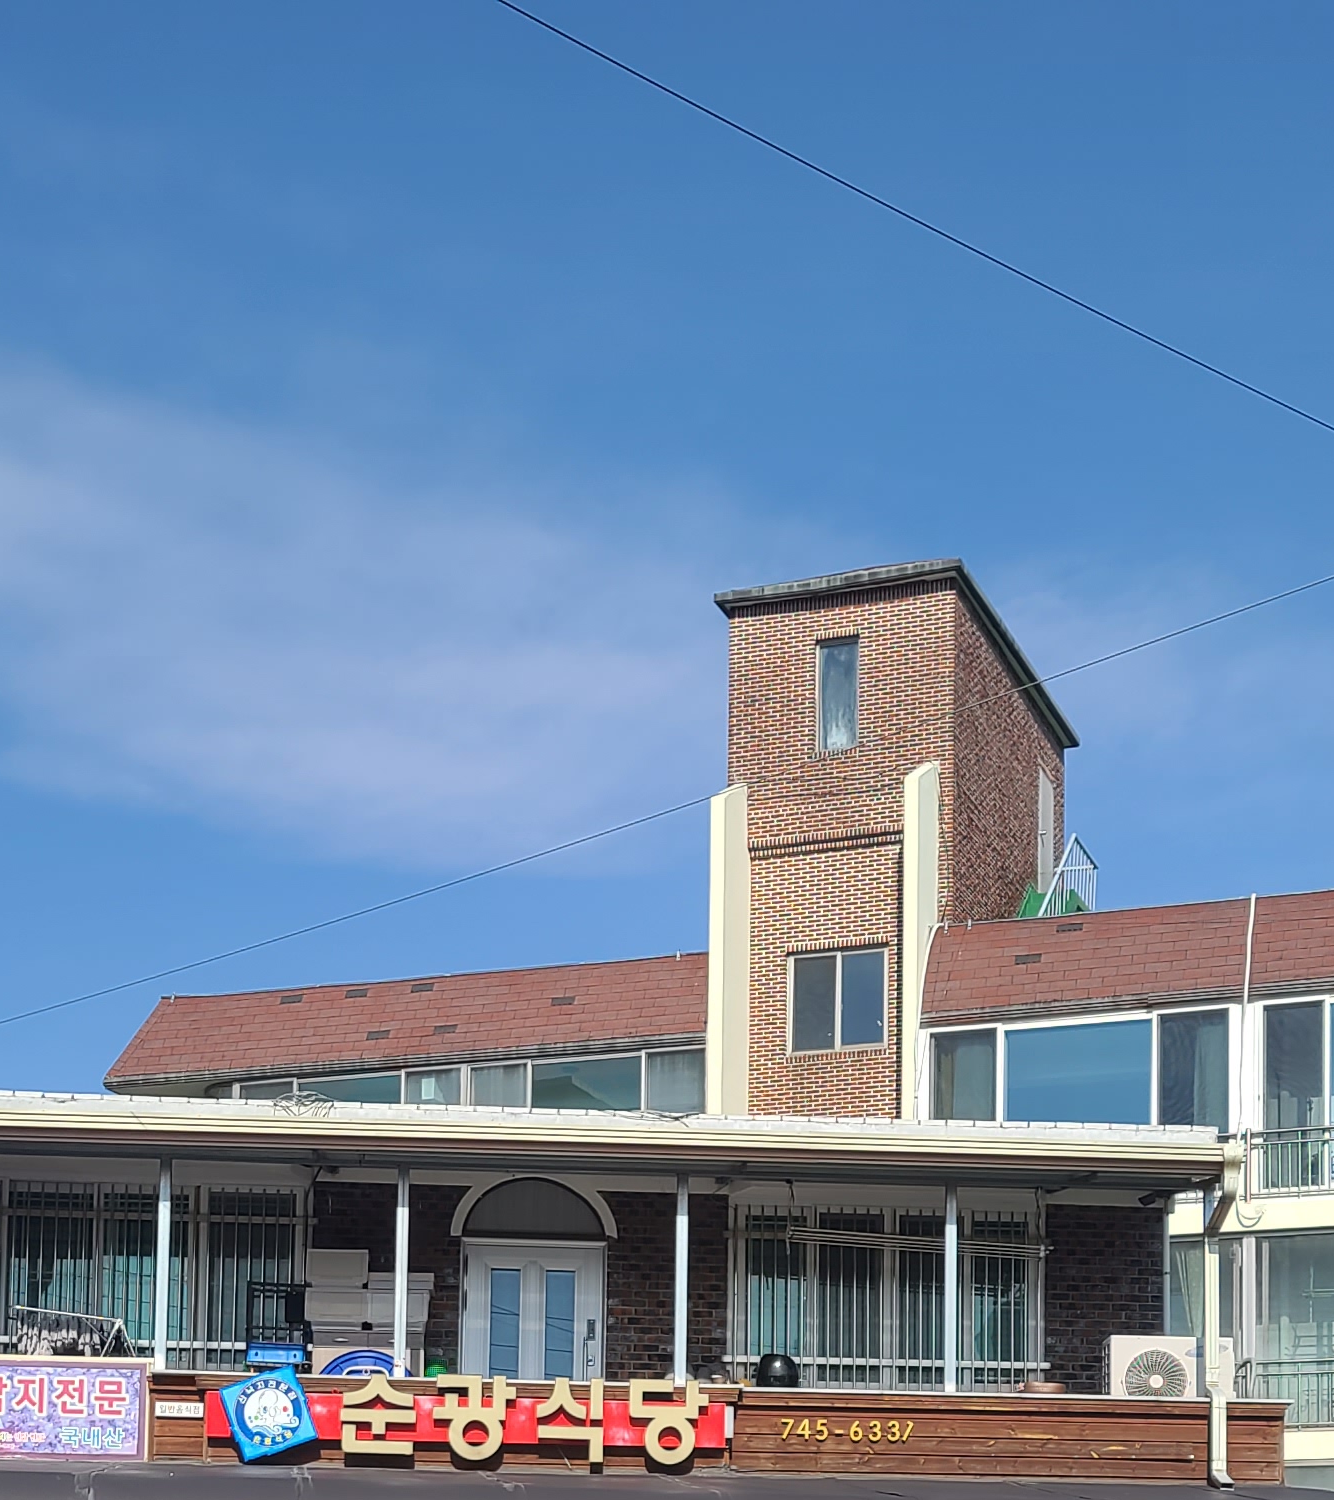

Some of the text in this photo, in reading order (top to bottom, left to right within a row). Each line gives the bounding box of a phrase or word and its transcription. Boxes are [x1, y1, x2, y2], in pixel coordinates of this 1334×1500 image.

[159, 1404, 200, 1415] 일반음식점
[340, 1373, 709, 1465] 순광식당
[60, 1426, 126, 1449] 국내산
[780, 1418, 915, 1443] 745-6337
